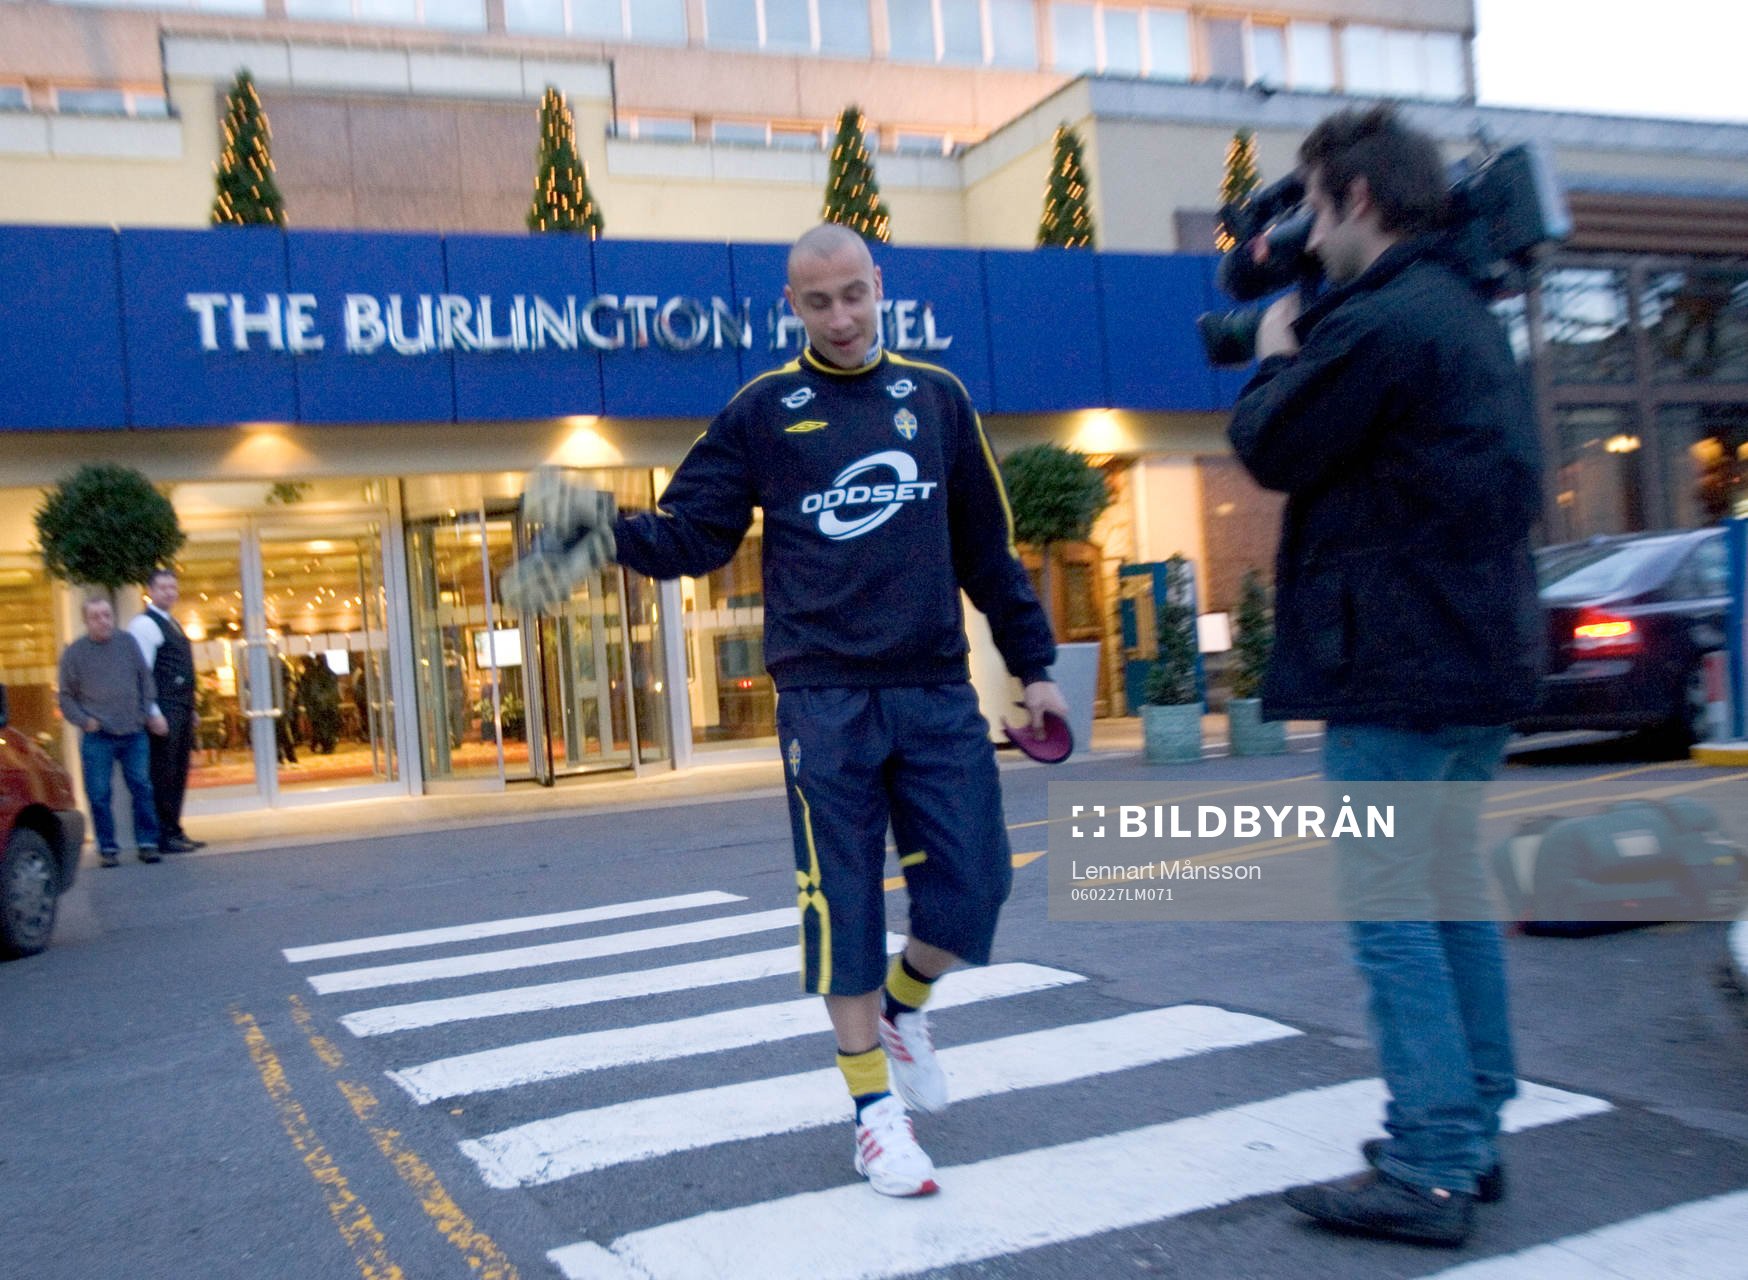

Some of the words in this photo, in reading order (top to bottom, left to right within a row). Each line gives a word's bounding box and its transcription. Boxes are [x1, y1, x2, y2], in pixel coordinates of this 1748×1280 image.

[187, 293, 324, 351] THE
[345, 294, 753, 354] BURLINGTON
[769, 297, 953, 350] HTEL
[801, 482, 938, 514] ODDSET
